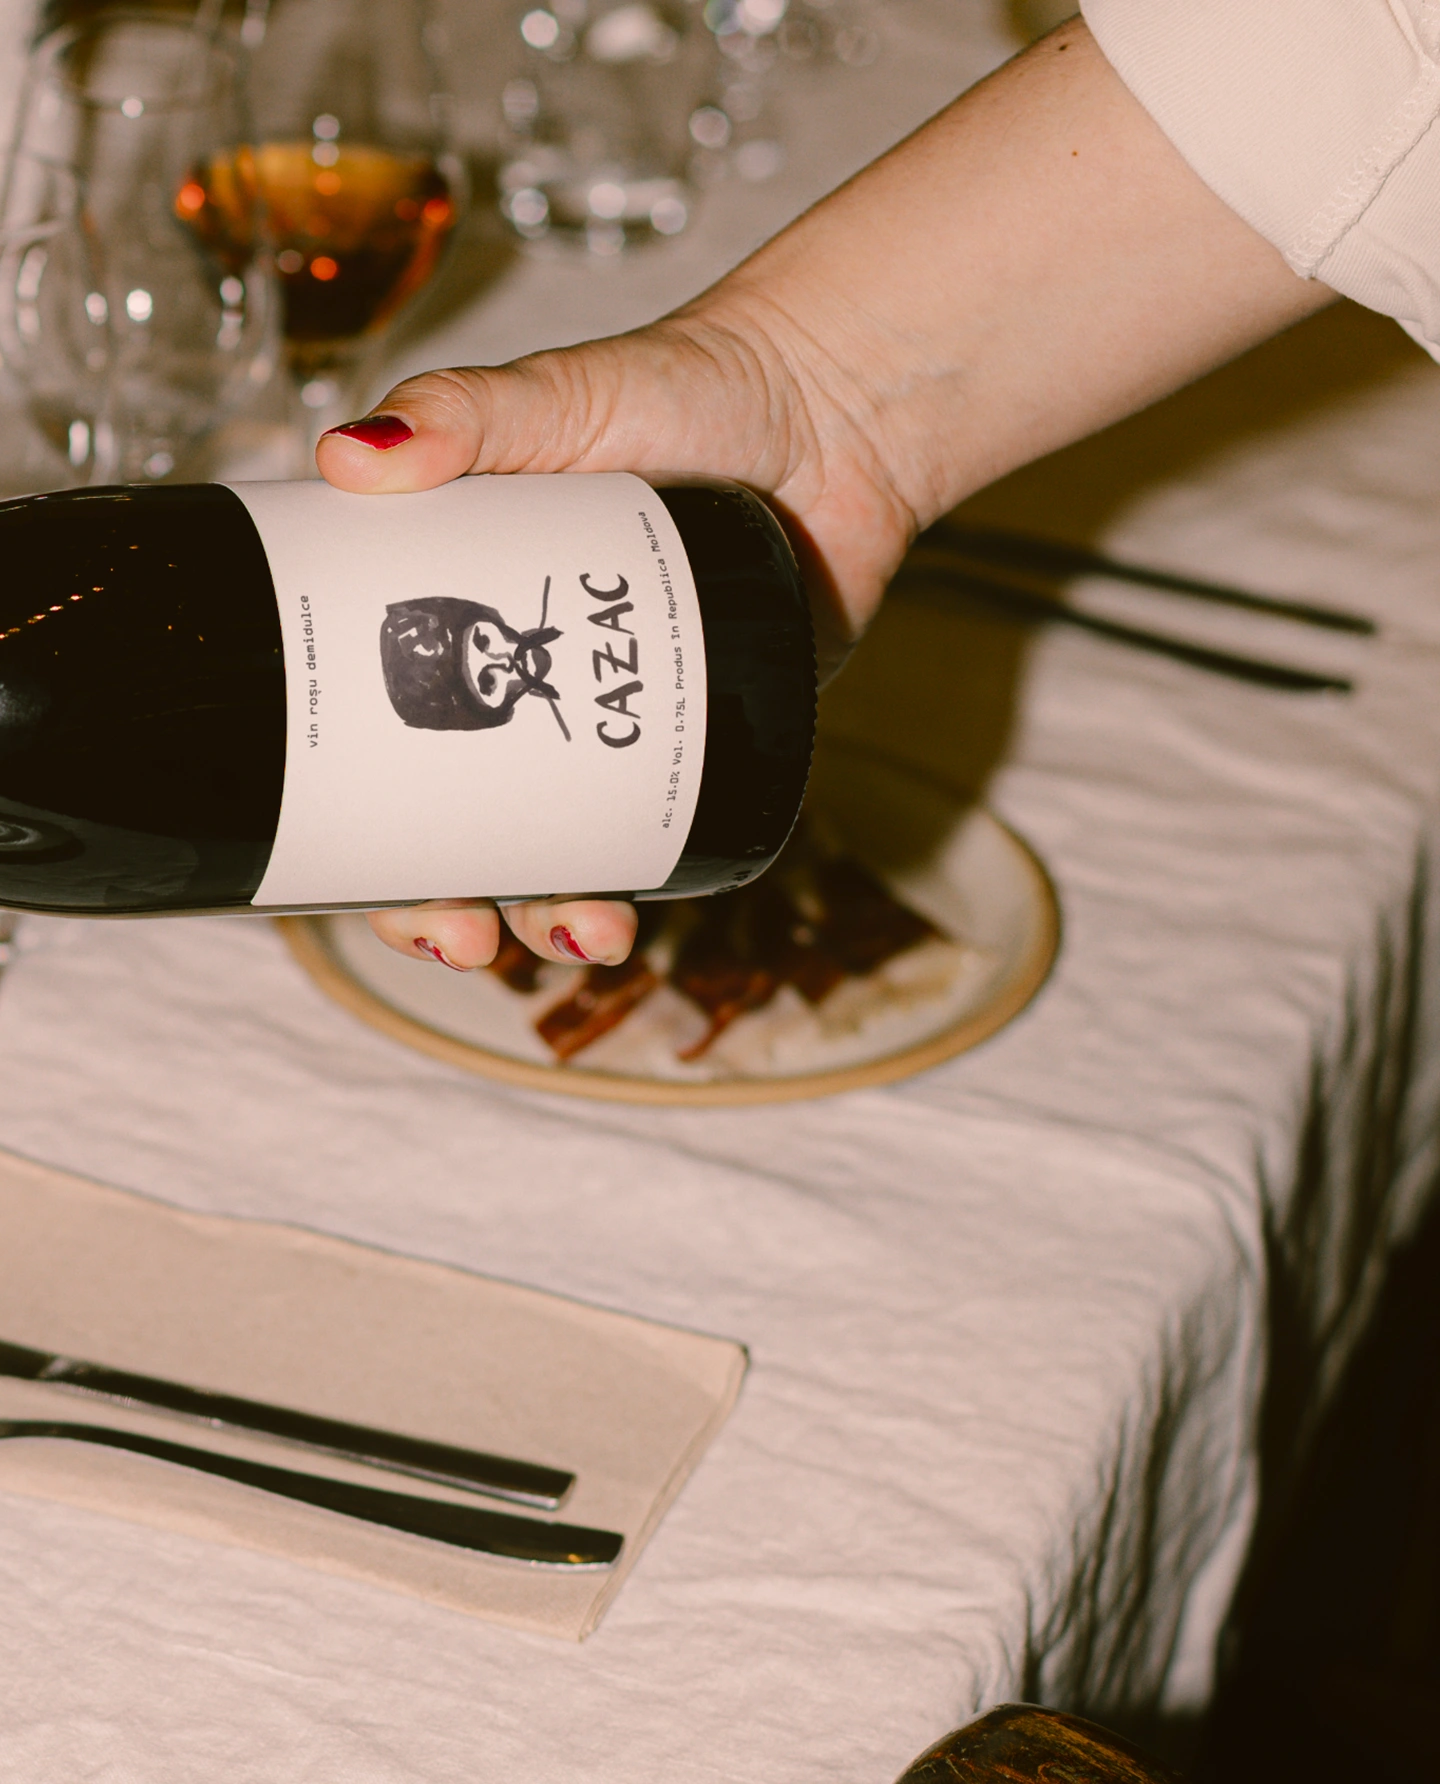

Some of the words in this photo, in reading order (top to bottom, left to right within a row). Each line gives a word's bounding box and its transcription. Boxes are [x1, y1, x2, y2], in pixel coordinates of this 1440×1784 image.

[637, 511, 661, 553] Moldova
[657, 558, 678, 620] Republica
[300, 594, 316, 671] demidulce
[579, 572, 643, 749] CAZAC
[674, 646, 685, 690] Produs
[675, 697, 686, 733] 0.75L
[307, 723, 319, 748] vin
[672, 740, 684, 766] Vol.
[666, 771, 680, 802] 15.0%
[661, 808, 673, 829] alc.
